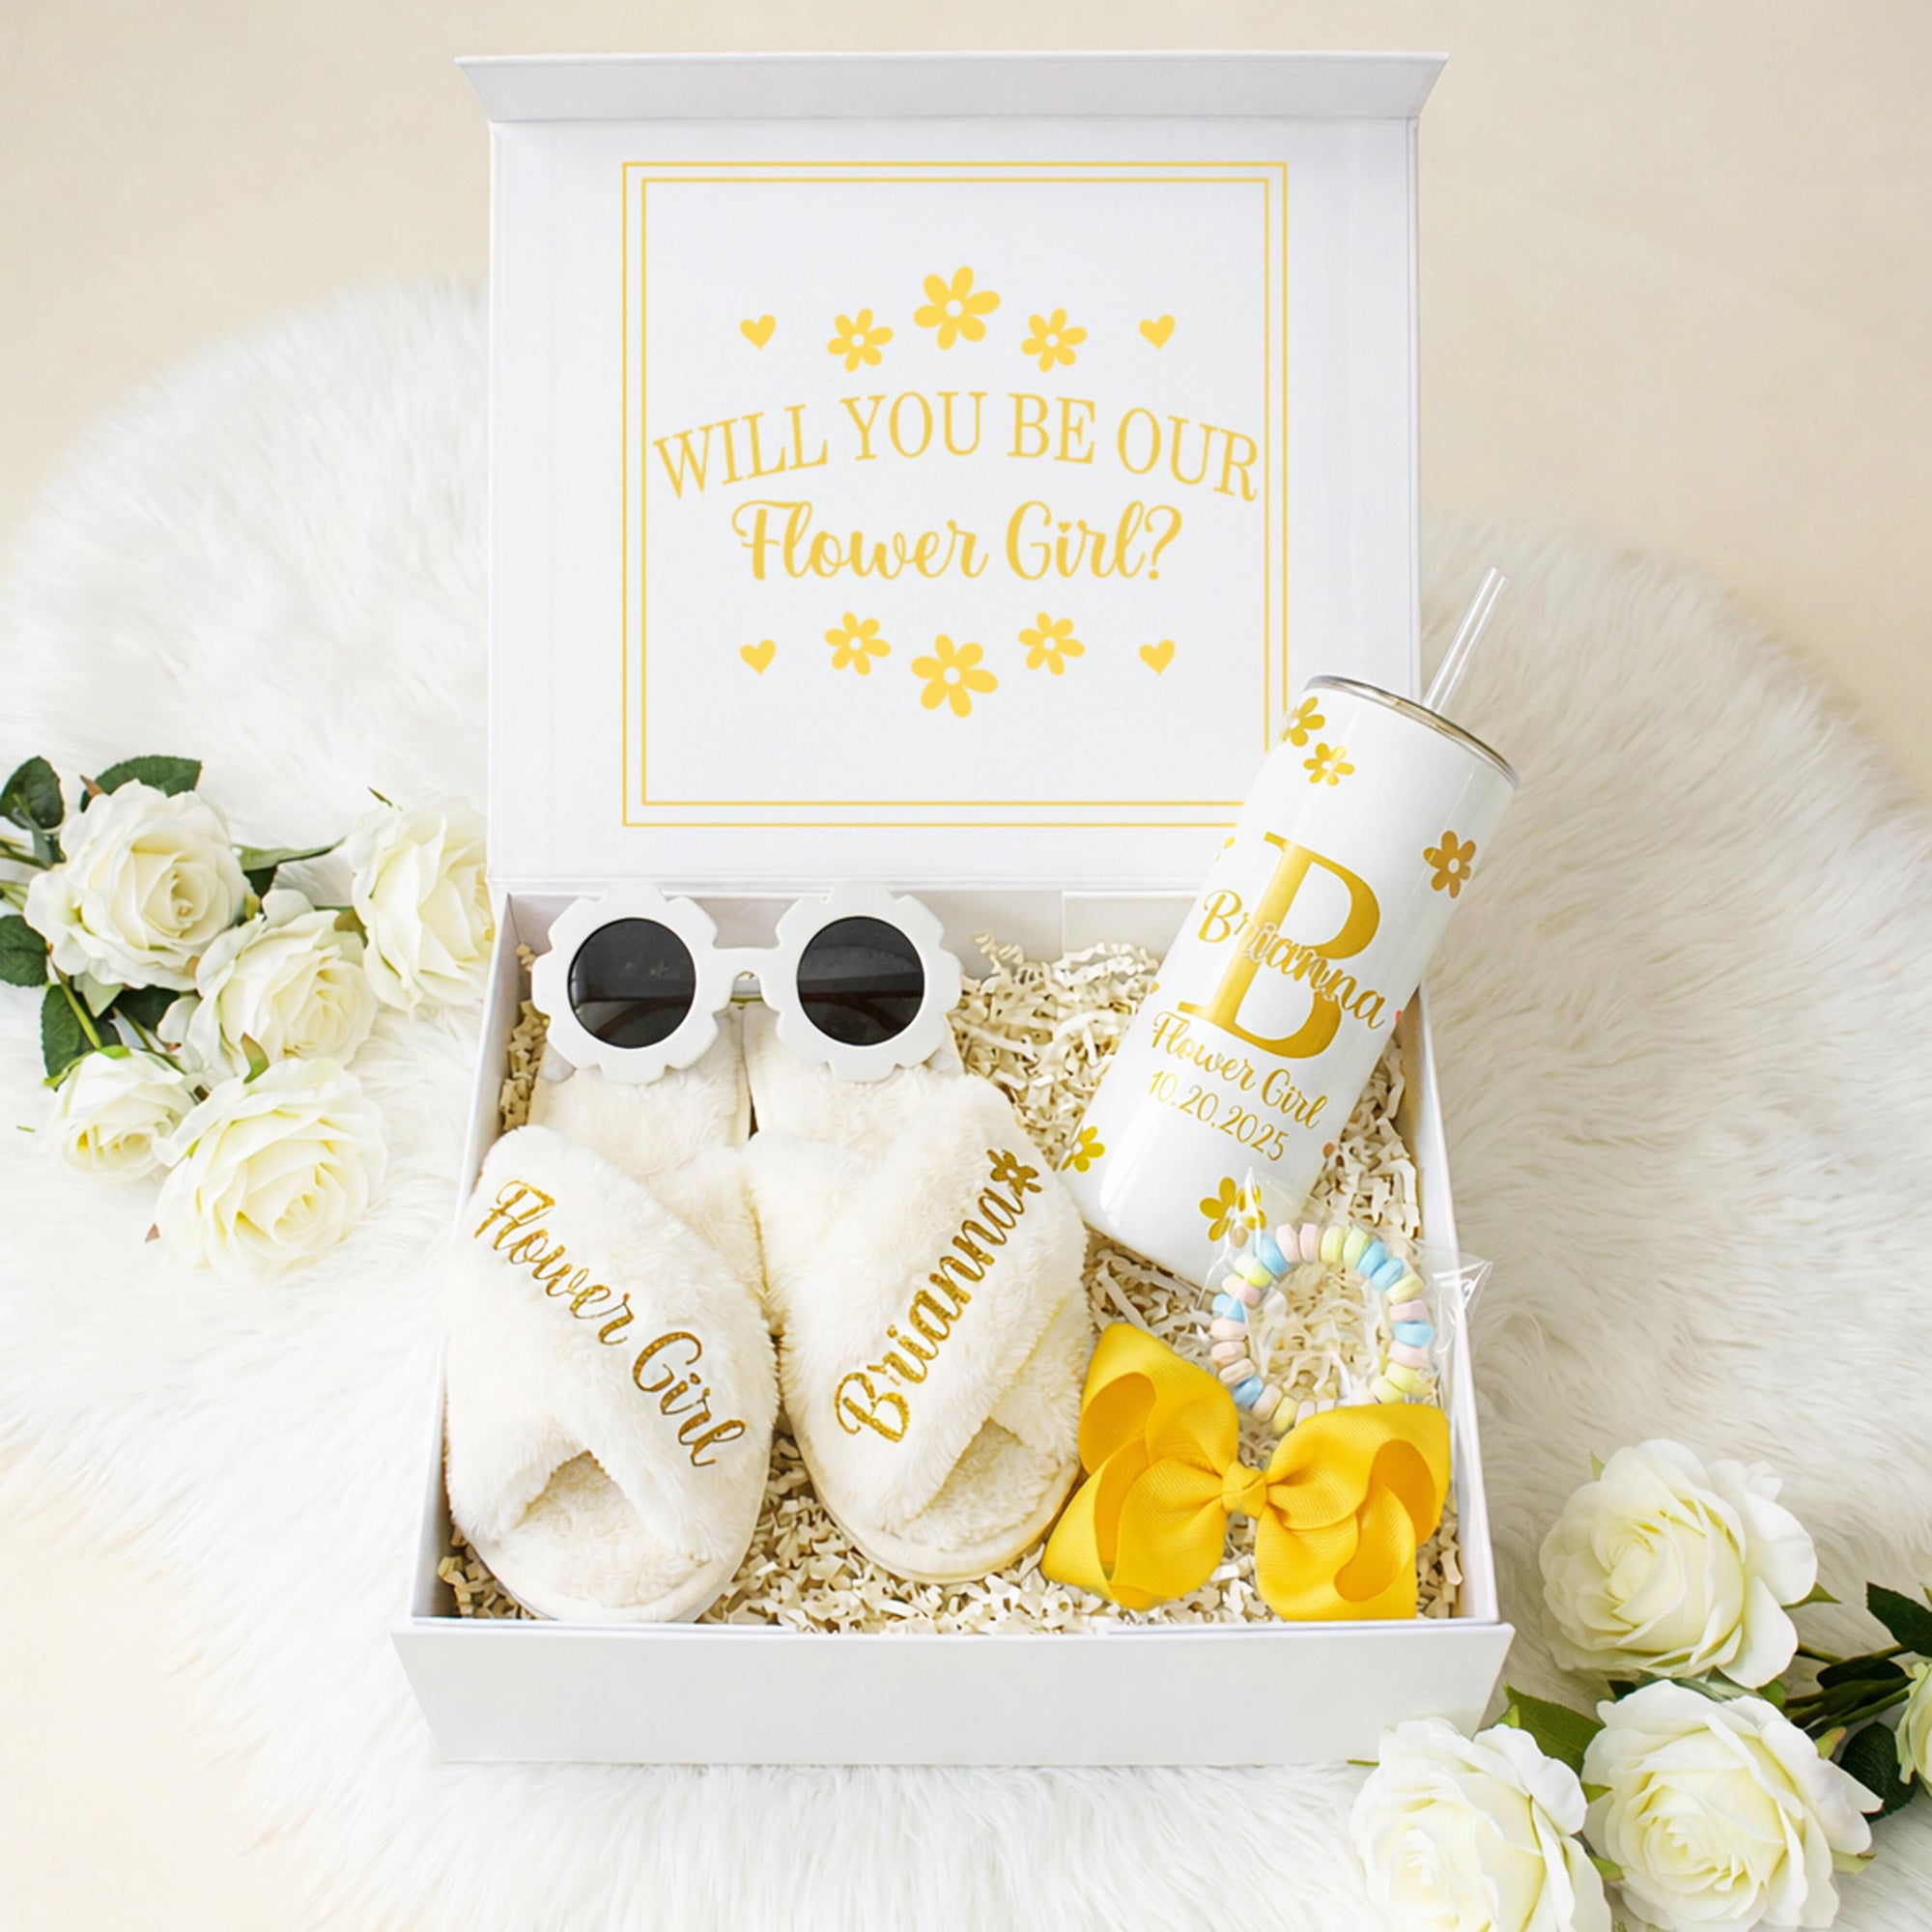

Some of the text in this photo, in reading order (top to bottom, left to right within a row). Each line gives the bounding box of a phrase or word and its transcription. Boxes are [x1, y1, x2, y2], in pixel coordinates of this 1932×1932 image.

[653, 391, 1259, 501] WILL YOU BE OUR
[731, 499, 1183, 581] Flower Girl?
[1178, 831, 1380, 1059] B
[1197, 889, 1386, 1030] Brianna
[1149, 1069, 1290, 1161] 10.20.2025
[1152, 1009, 1328, 1129] Flower Girl
[474, 1179, 746, 1466] Flower Girl
[835, 1186, 1026, 1443] Brianna
